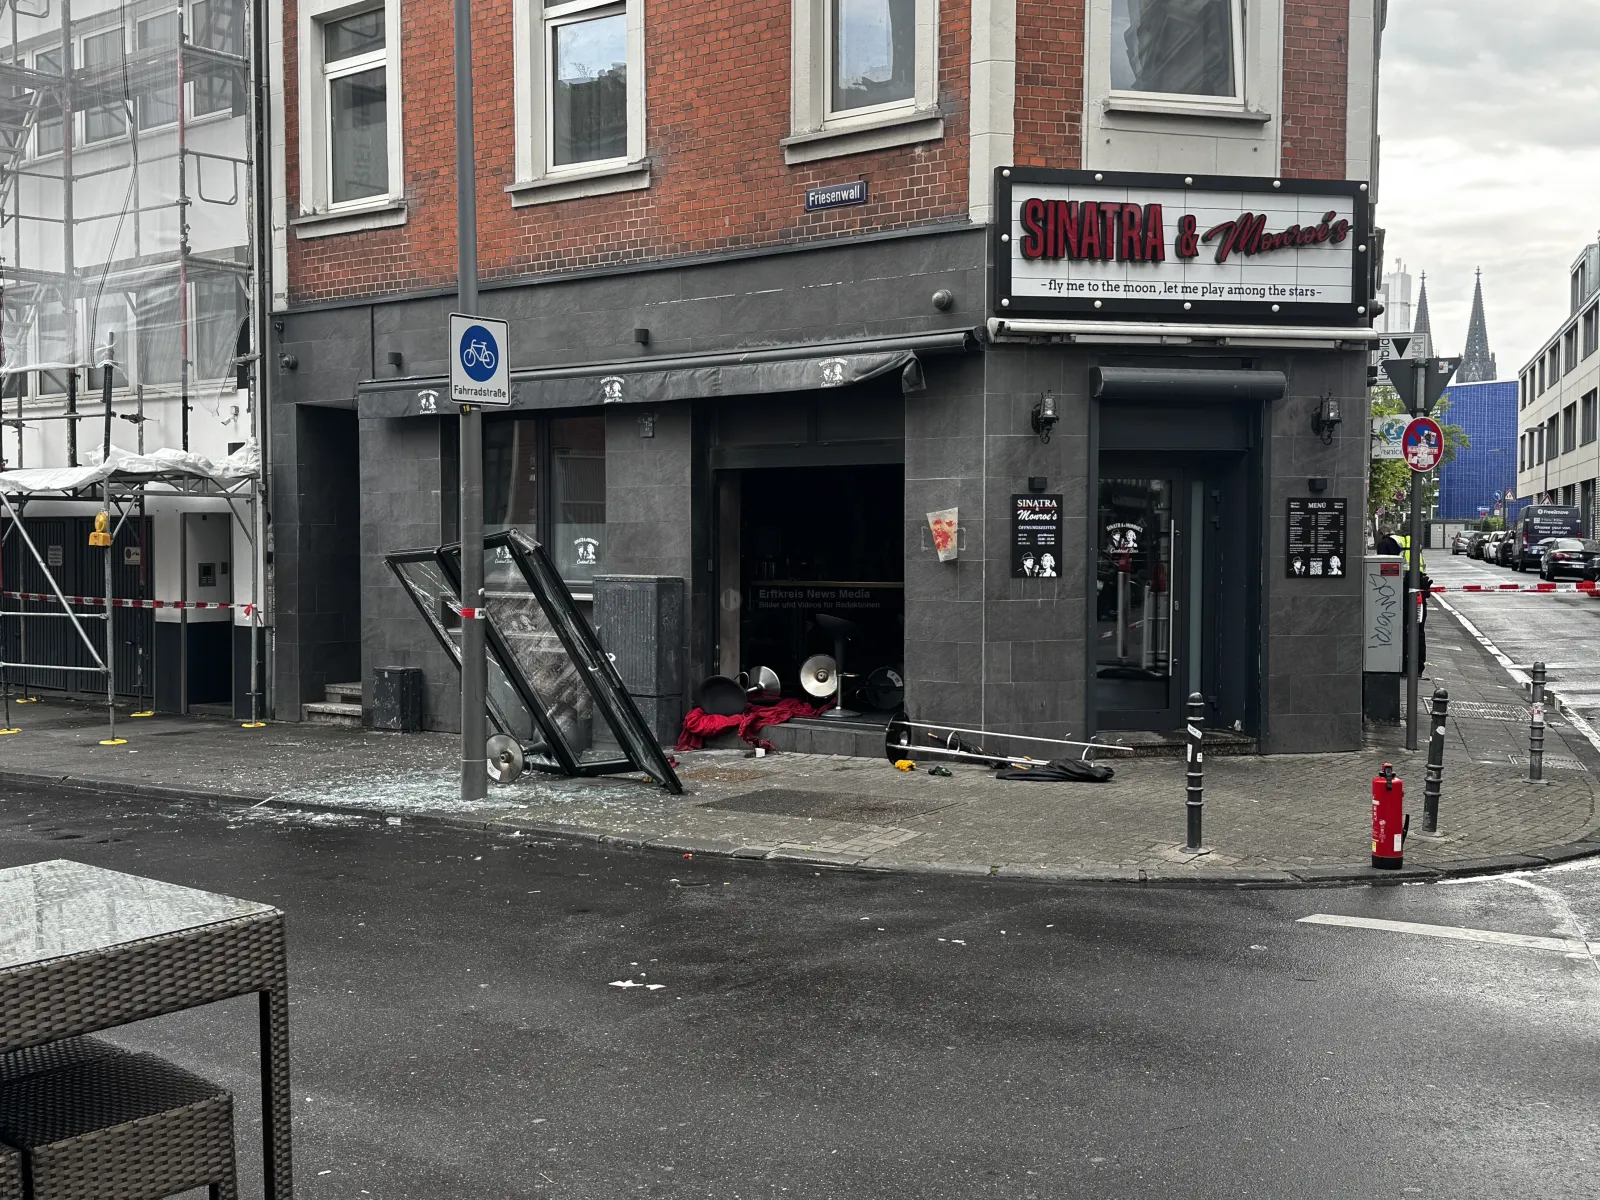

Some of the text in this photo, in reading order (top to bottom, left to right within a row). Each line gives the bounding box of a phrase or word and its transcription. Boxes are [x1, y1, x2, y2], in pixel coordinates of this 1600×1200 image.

[809, 184, 860, 206] Friesenwall
[1020, 198, 1165, 261] SINATRA
[1175, 214, 1199, 258] &
[1066, 282, 1084, 291] me
[1088, 281, 1099, 291] to
[1102, 280, 1120, 292] the
[1181, 285, 1198, 294] me
[1201, 283, 1225, 296] play
[1227, 286, 1265, 298] among
[1268, 284, 1286, 296] the
[453, 384, 507, 398] Fahrradstraße
[1017, 499, 1057, 507] SINATRA
[1017, 510, 1057, 520] Monroe's
